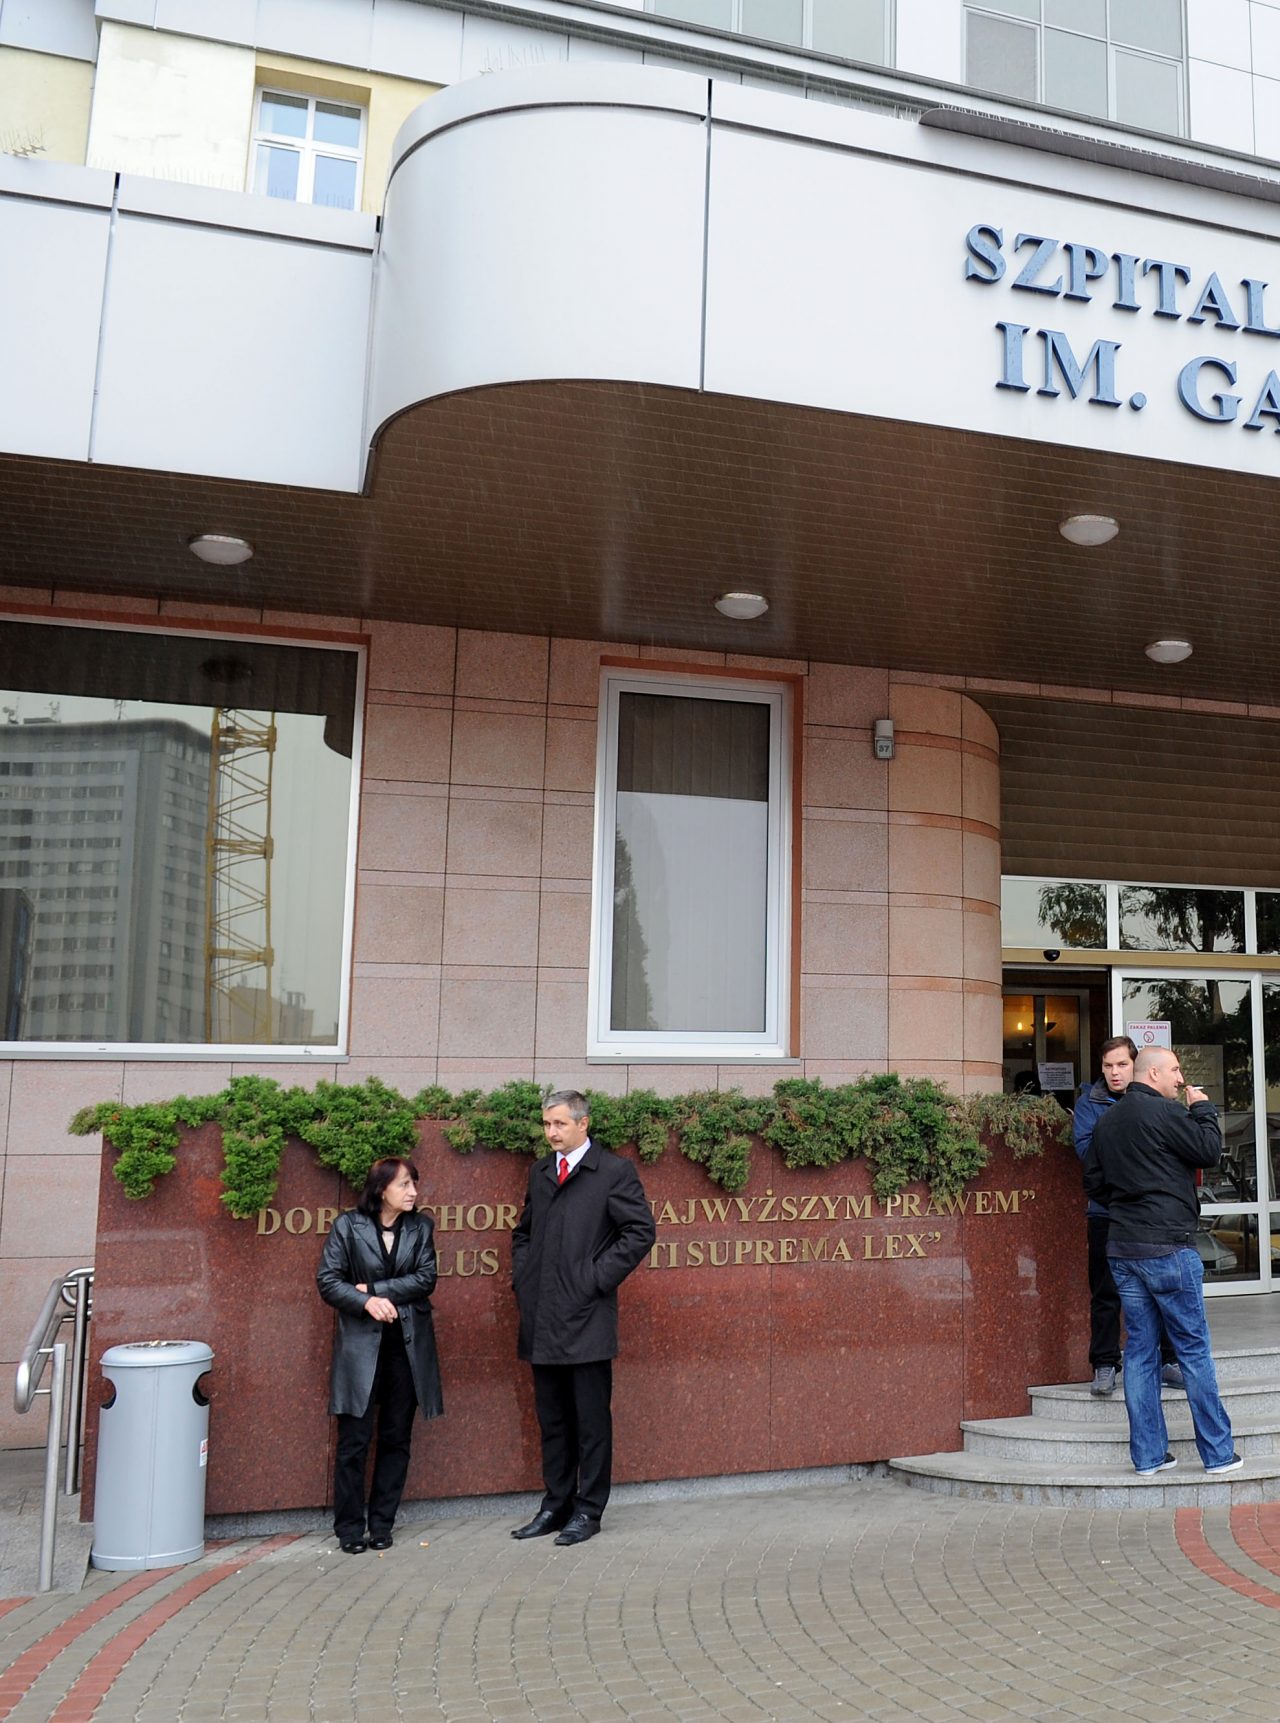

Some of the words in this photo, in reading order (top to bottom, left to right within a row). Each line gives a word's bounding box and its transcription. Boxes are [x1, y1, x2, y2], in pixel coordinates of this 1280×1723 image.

[995, 320, 1147, 411] IM.
[650, 1189, 874, 1225] AJWYŻSZYM
[436, 1247, 500, 1277] LUS
[686, 1236, 854, 1267] SUPREMA
